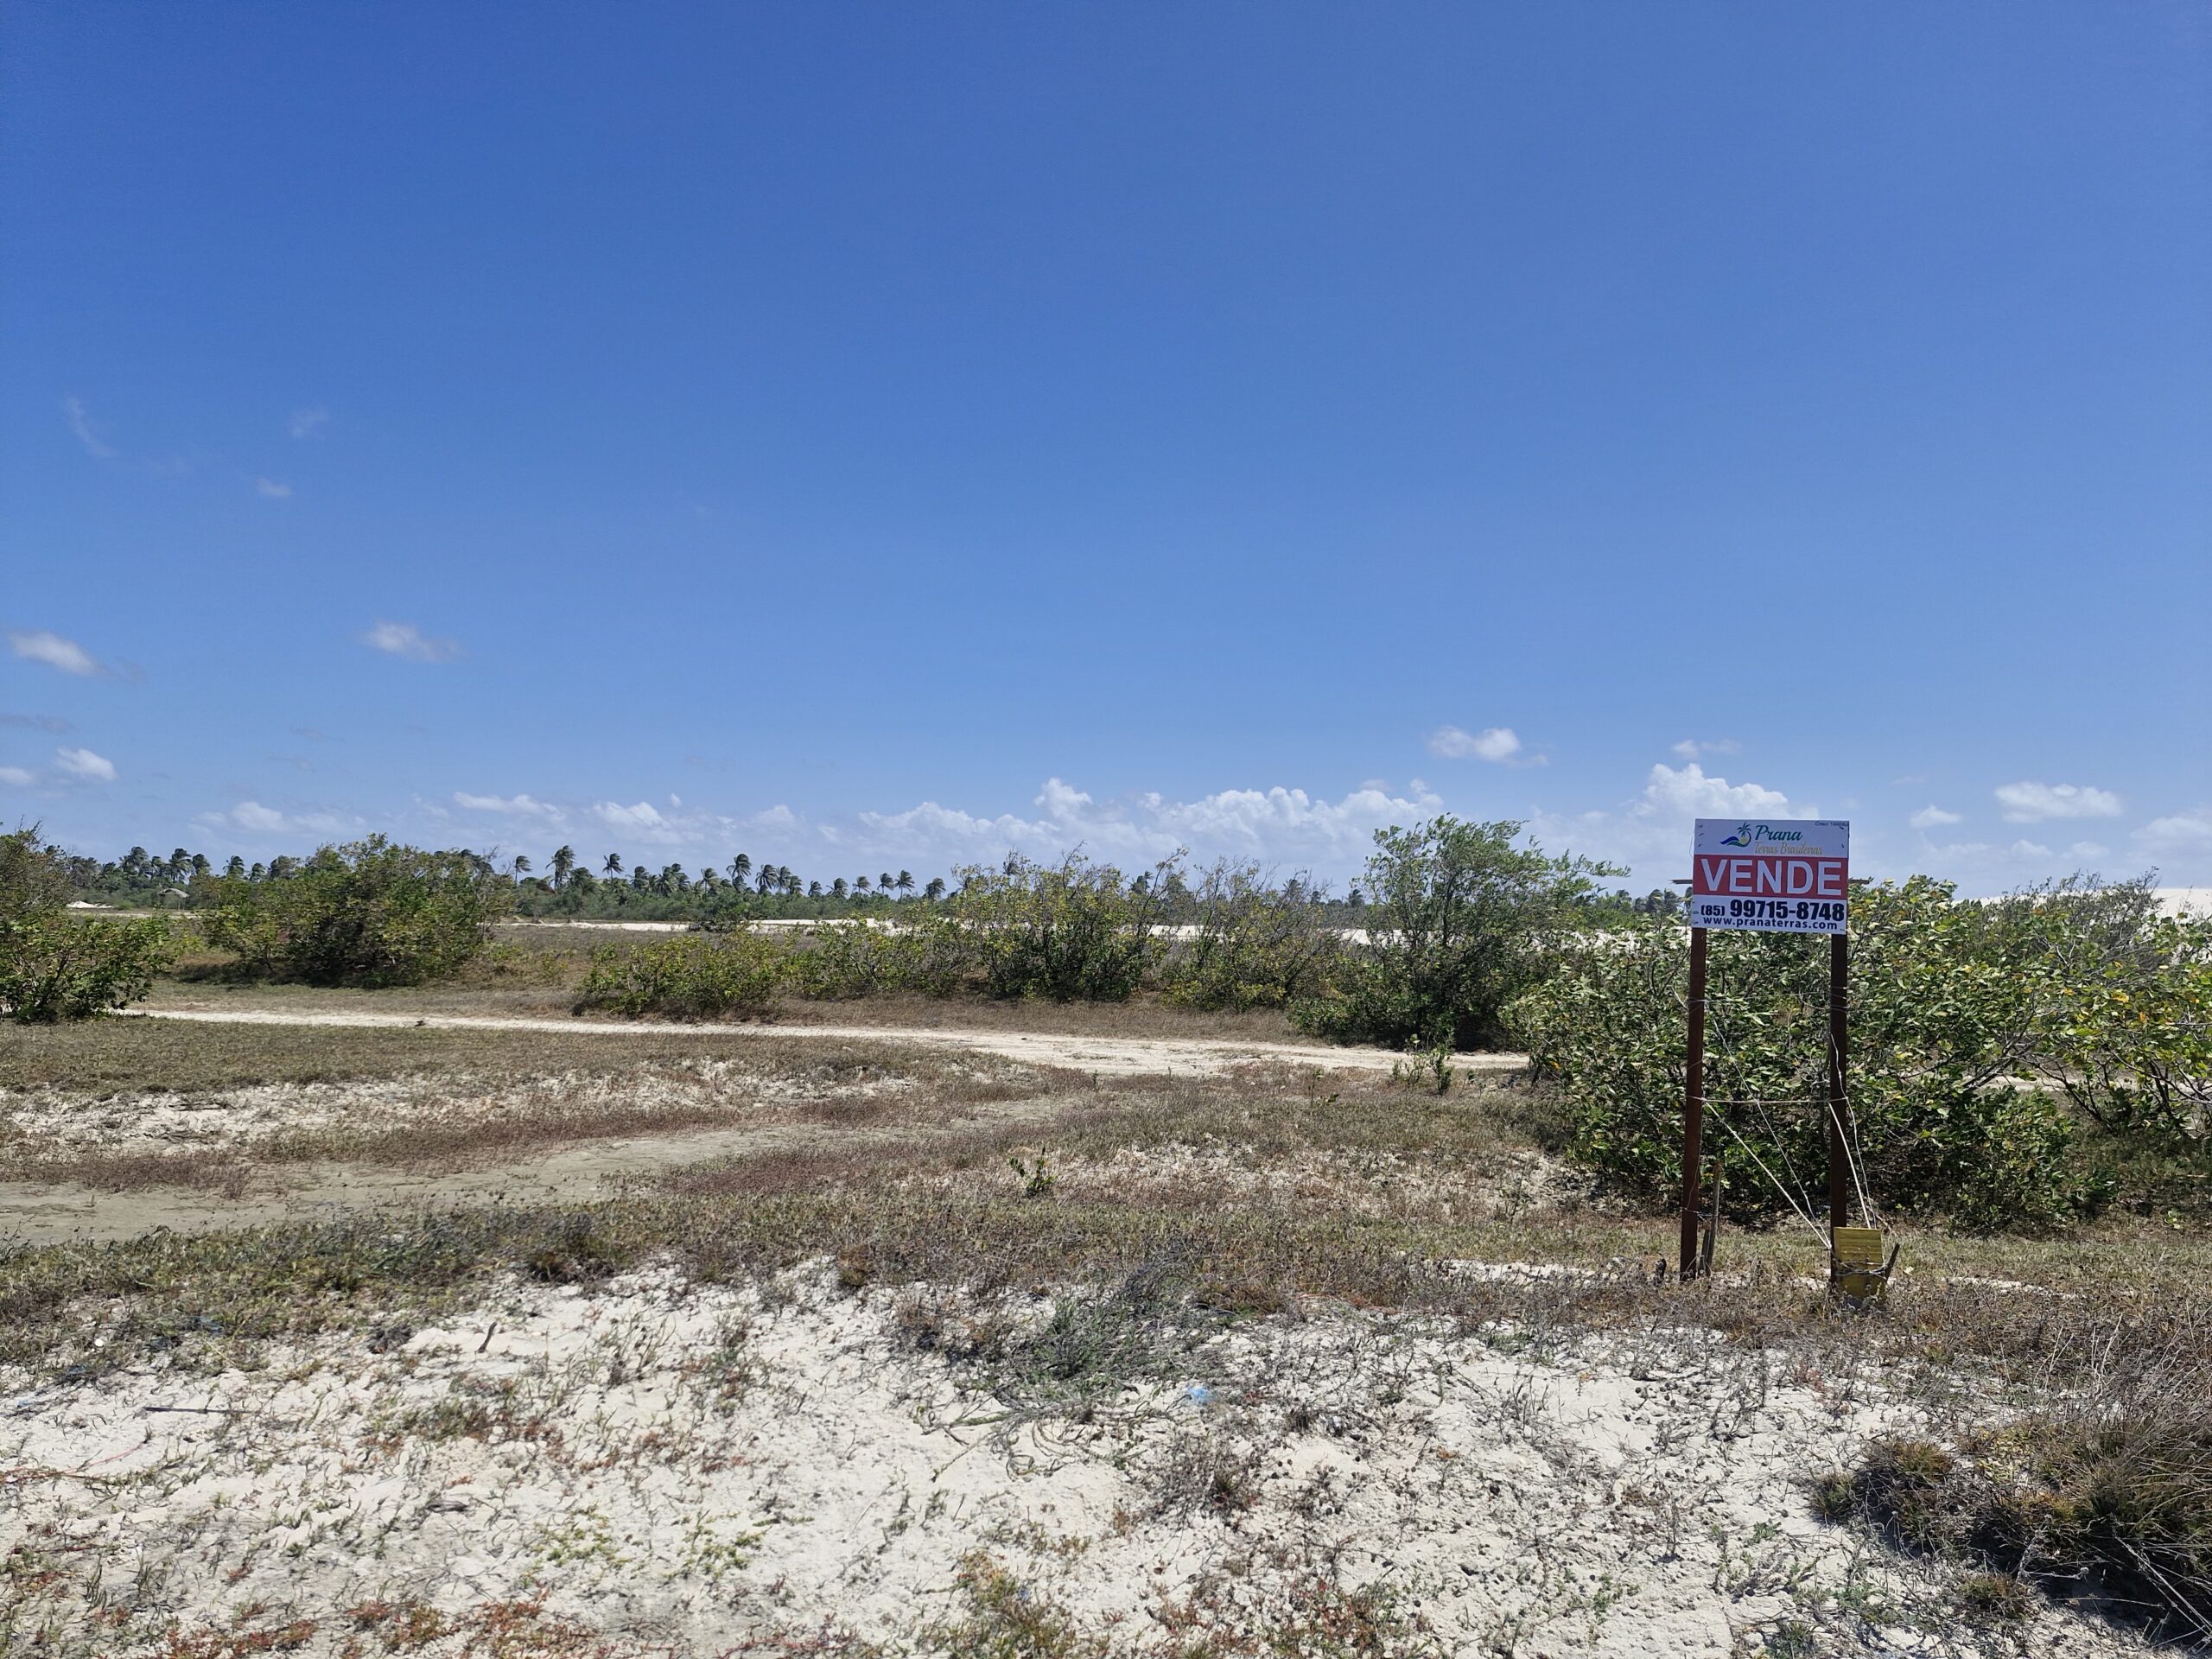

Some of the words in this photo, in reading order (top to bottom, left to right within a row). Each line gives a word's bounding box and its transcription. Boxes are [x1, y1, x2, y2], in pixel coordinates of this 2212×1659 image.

[1755, 824, 1803, 841] Prana
[1755, 841, 1777, 854] Terras
[1700, 858, 1842, 896] VENDE
[1700, 905, 1726, 917] (85)
[1730, 899, 1845, 922] 99715-8748
[1703, 916, 1838, 930] www.pranaterras.com
